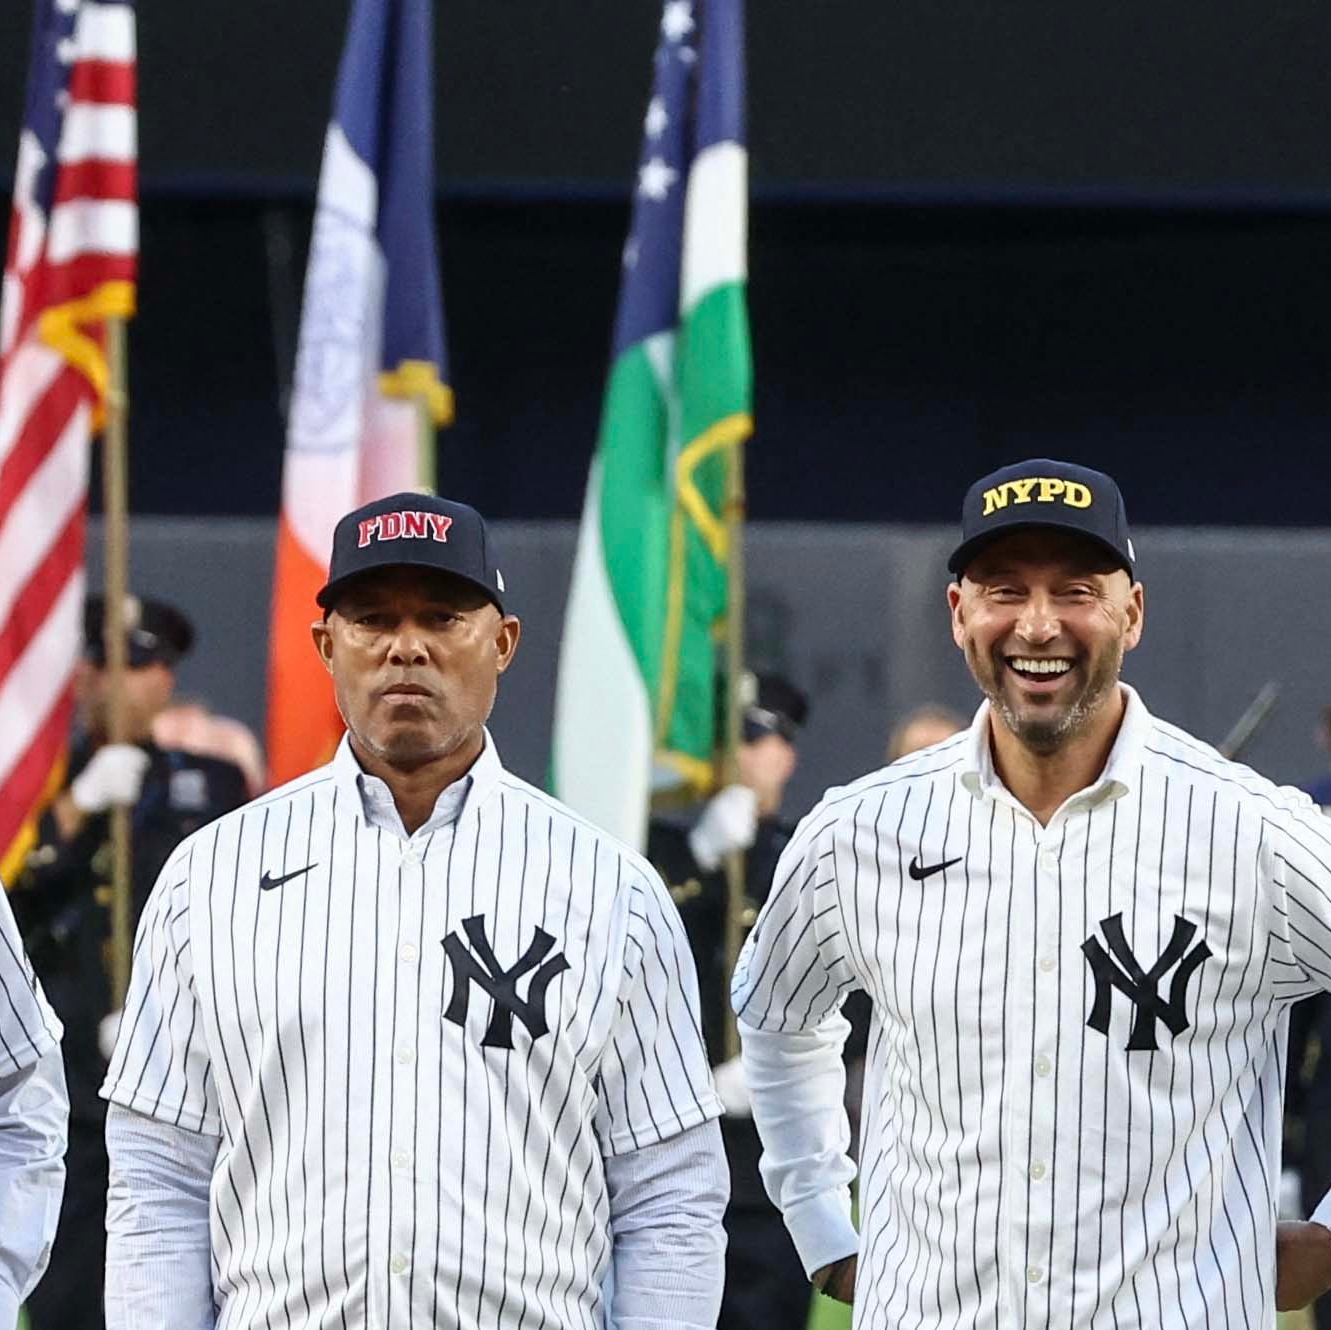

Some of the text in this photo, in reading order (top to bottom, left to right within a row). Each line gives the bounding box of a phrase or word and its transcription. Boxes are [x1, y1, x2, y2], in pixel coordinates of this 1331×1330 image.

[358, 511, 453, 548] FDNY
[983, 478, 1092, 516] NYPD
[440, 914, 572, 1049] NY
[1080, 911, 1213, 1052] NY
